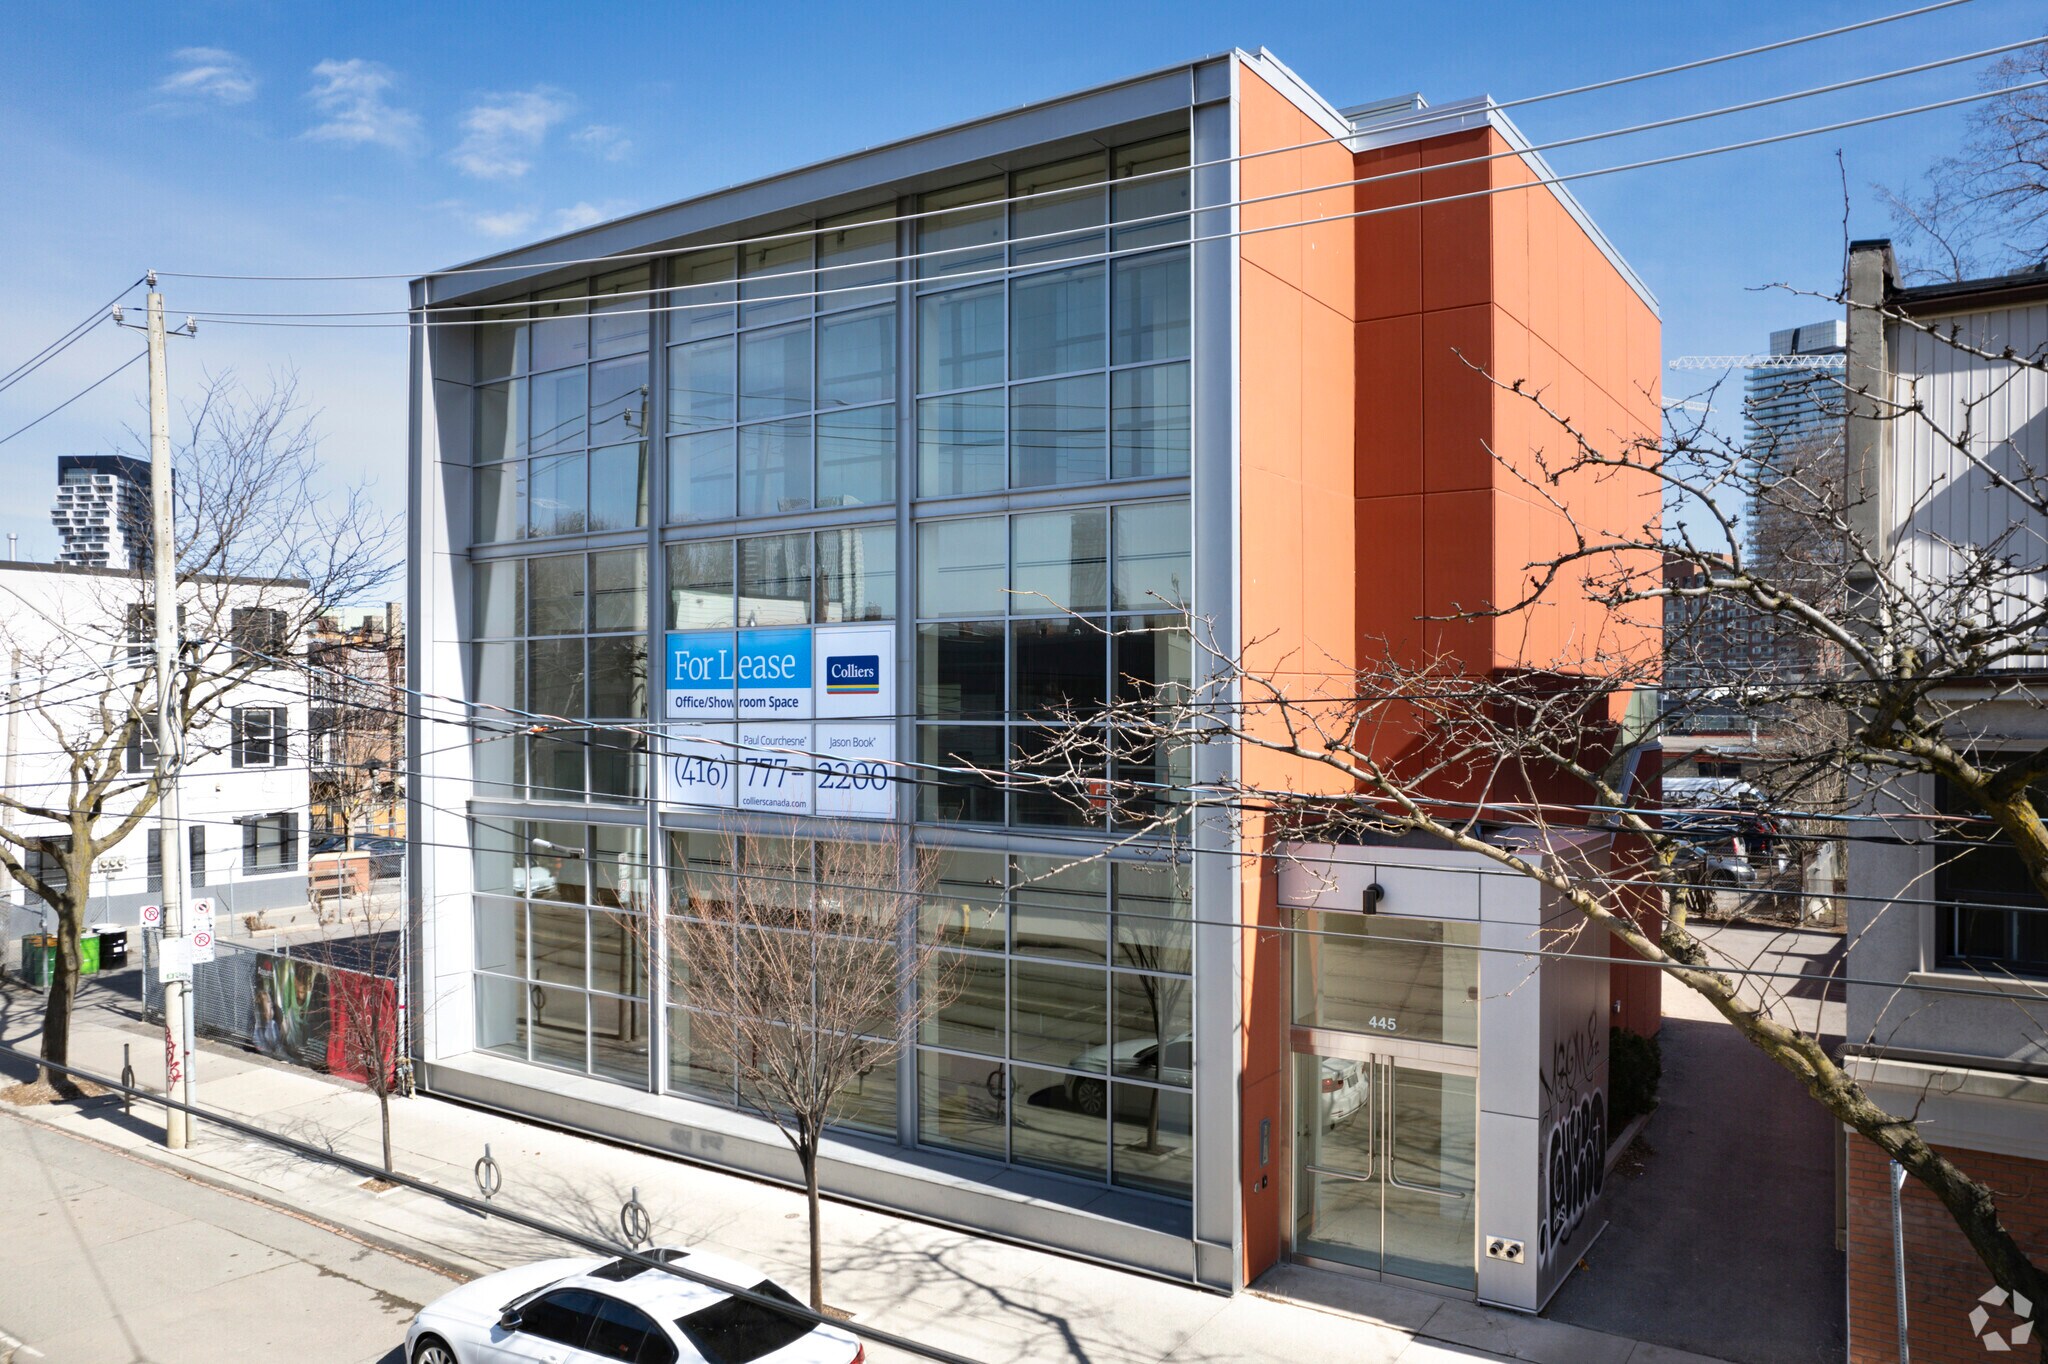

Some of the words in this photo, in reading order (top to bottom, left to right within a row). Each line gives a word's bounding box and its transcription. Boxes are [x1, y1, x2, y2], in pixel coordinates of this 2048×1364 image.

[674, 650, 714, 681] For
[718, 649, 796, 680] Lease
[831, 663, 875, 679] Colliers
[675, 695, 766, 708] Office/Showroom
[768, 696, 799, 711] Space
[743, 735, 760, 746] Paul
[829, 736, 851, 749] Jason
[674, 753, 728, 790] (416)
[742, 797, 807, 808] collierscanada.com
[1368, 1015, 1397, 1031] 445
